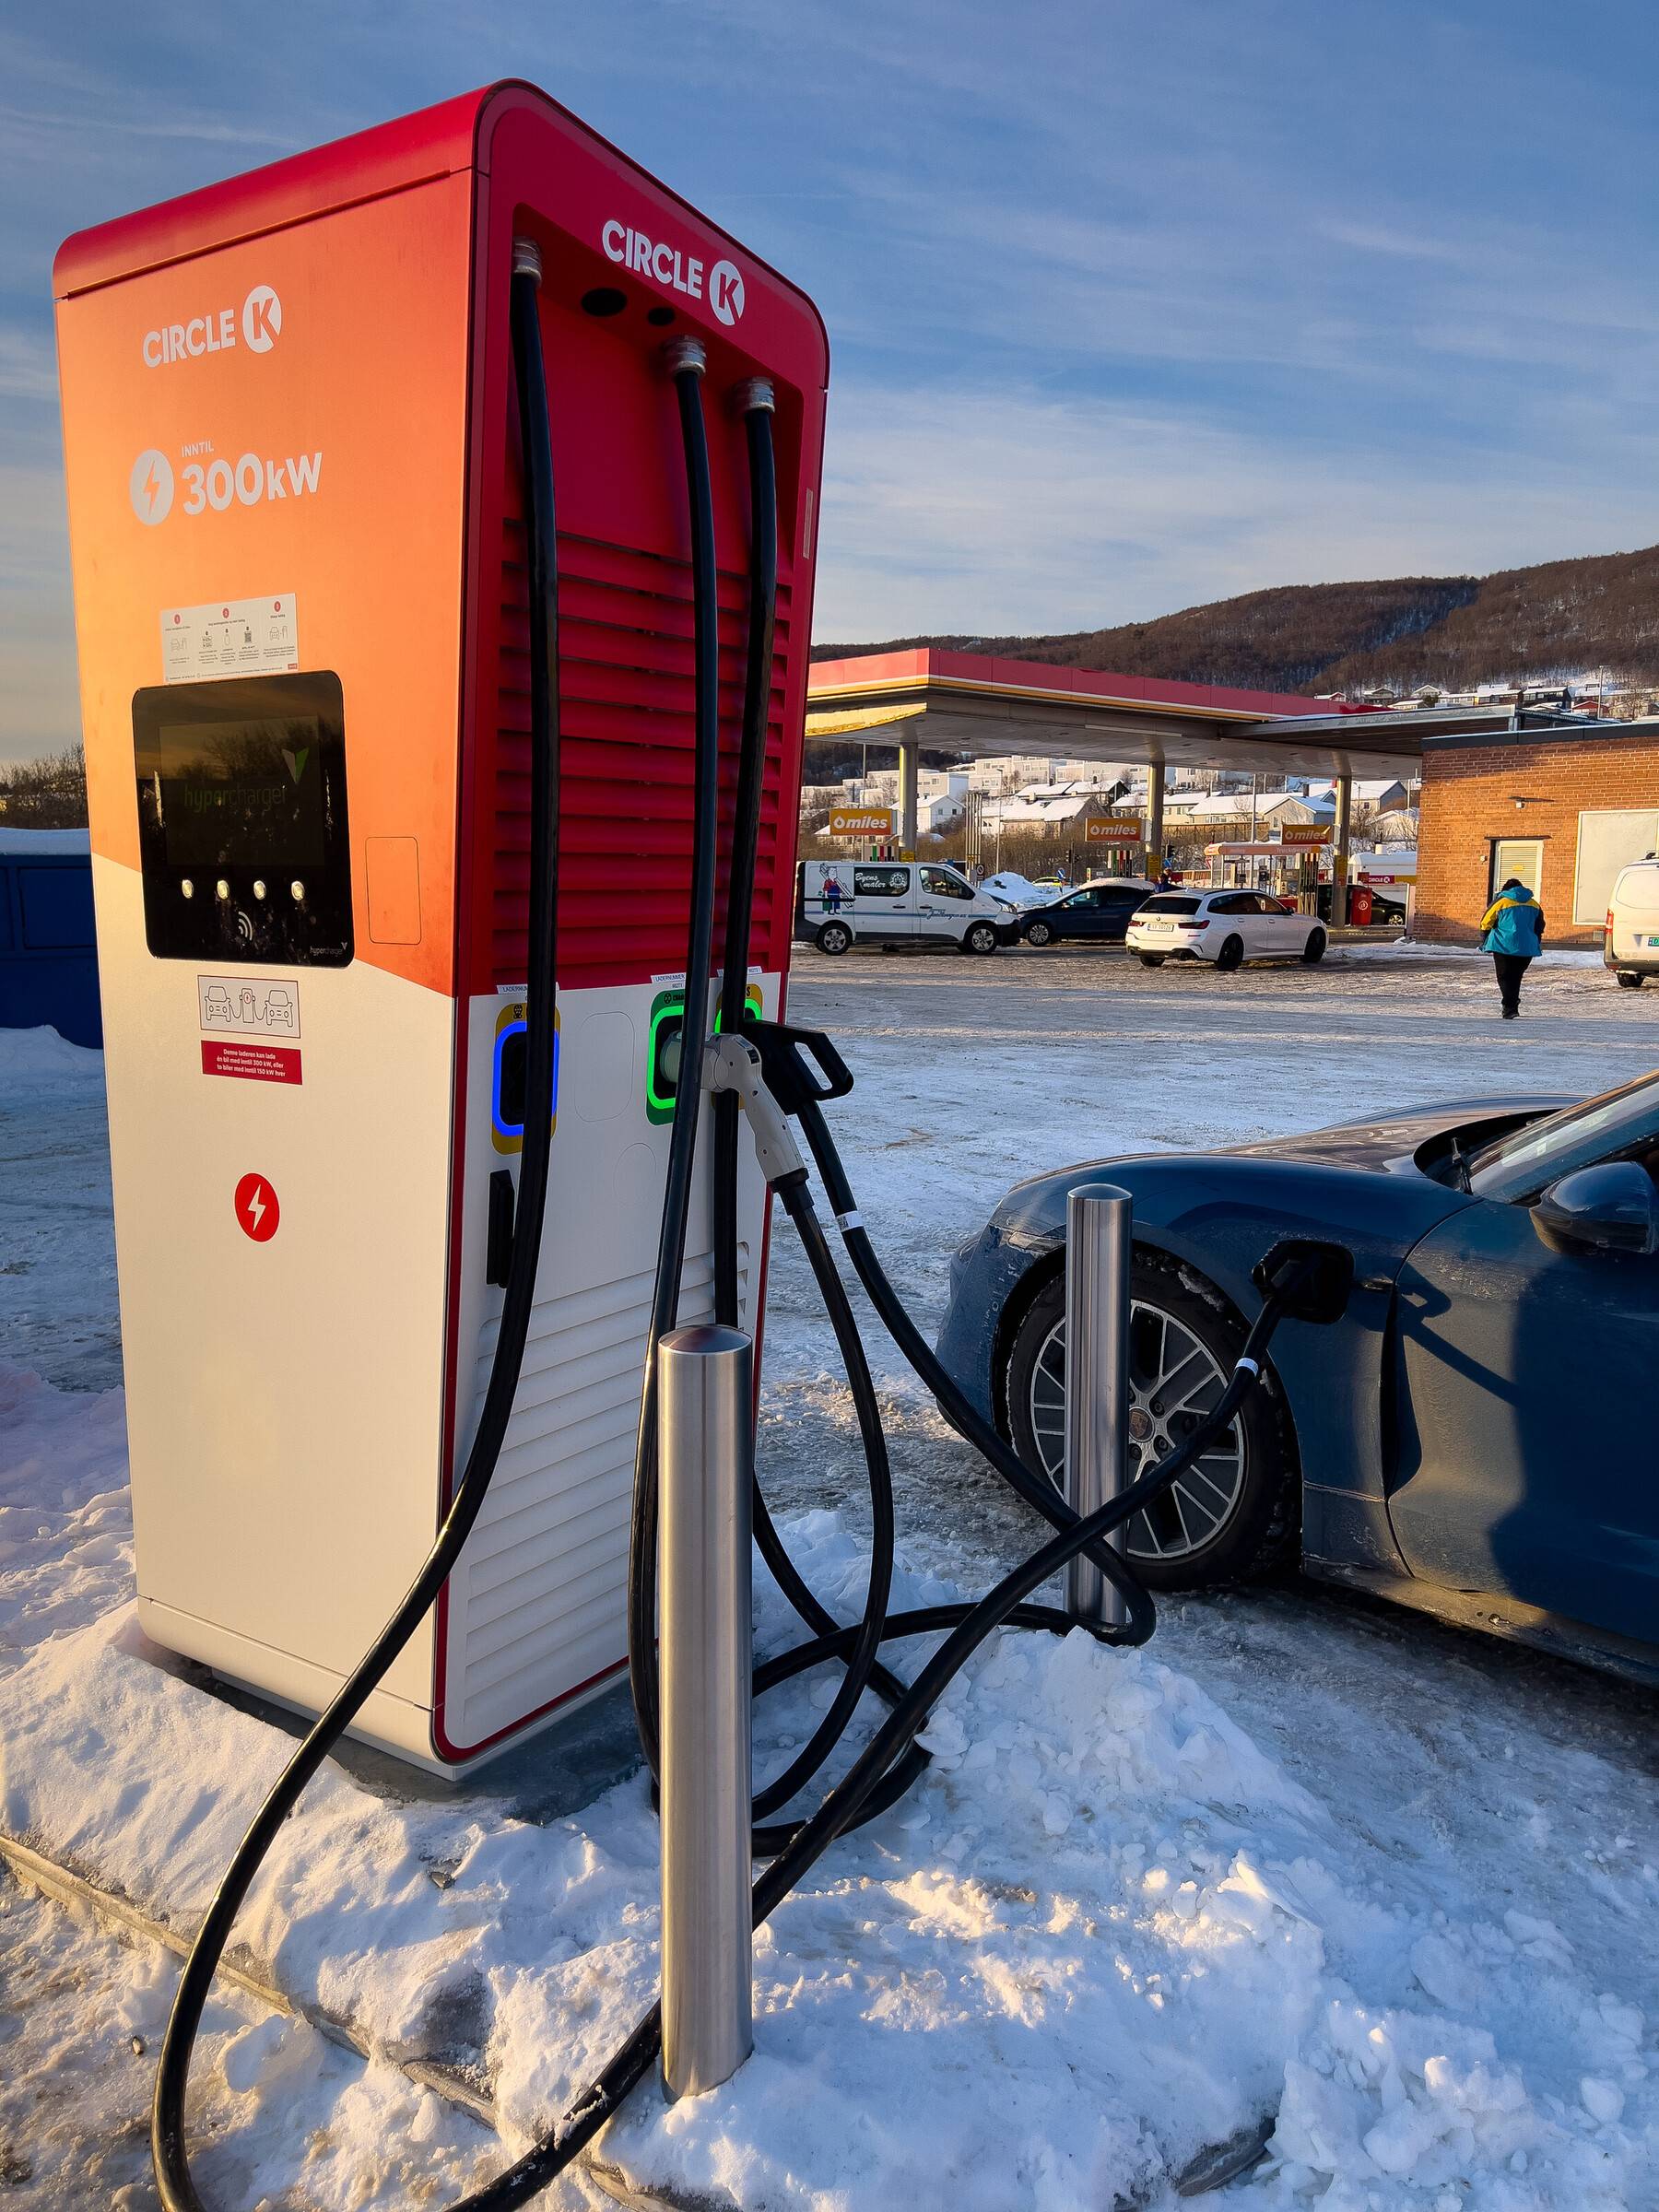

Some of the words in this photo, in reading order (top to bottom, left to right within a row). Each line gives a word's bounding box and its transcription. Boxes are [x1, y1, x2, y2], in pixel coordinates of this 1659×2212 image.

[602, 219, 703, 300] CIRCLE
[711, 264, 744, 325] K
[143, 309, 236, 368] CIRCLE
[245, 289, 281, 353] K
[182, 441, 214, 457] INNTIL
[182, 453, 323, 515] 300kW
[183, 782, 287, 813] hypercharger
[845, 816, 888, 829] miles
[1100, 824, 1137, 835] miles
[1293, 830, 1326, 840] miles
[855, 872, 878, 882] Byens
[238, 1050, 255, 1058] laderen
